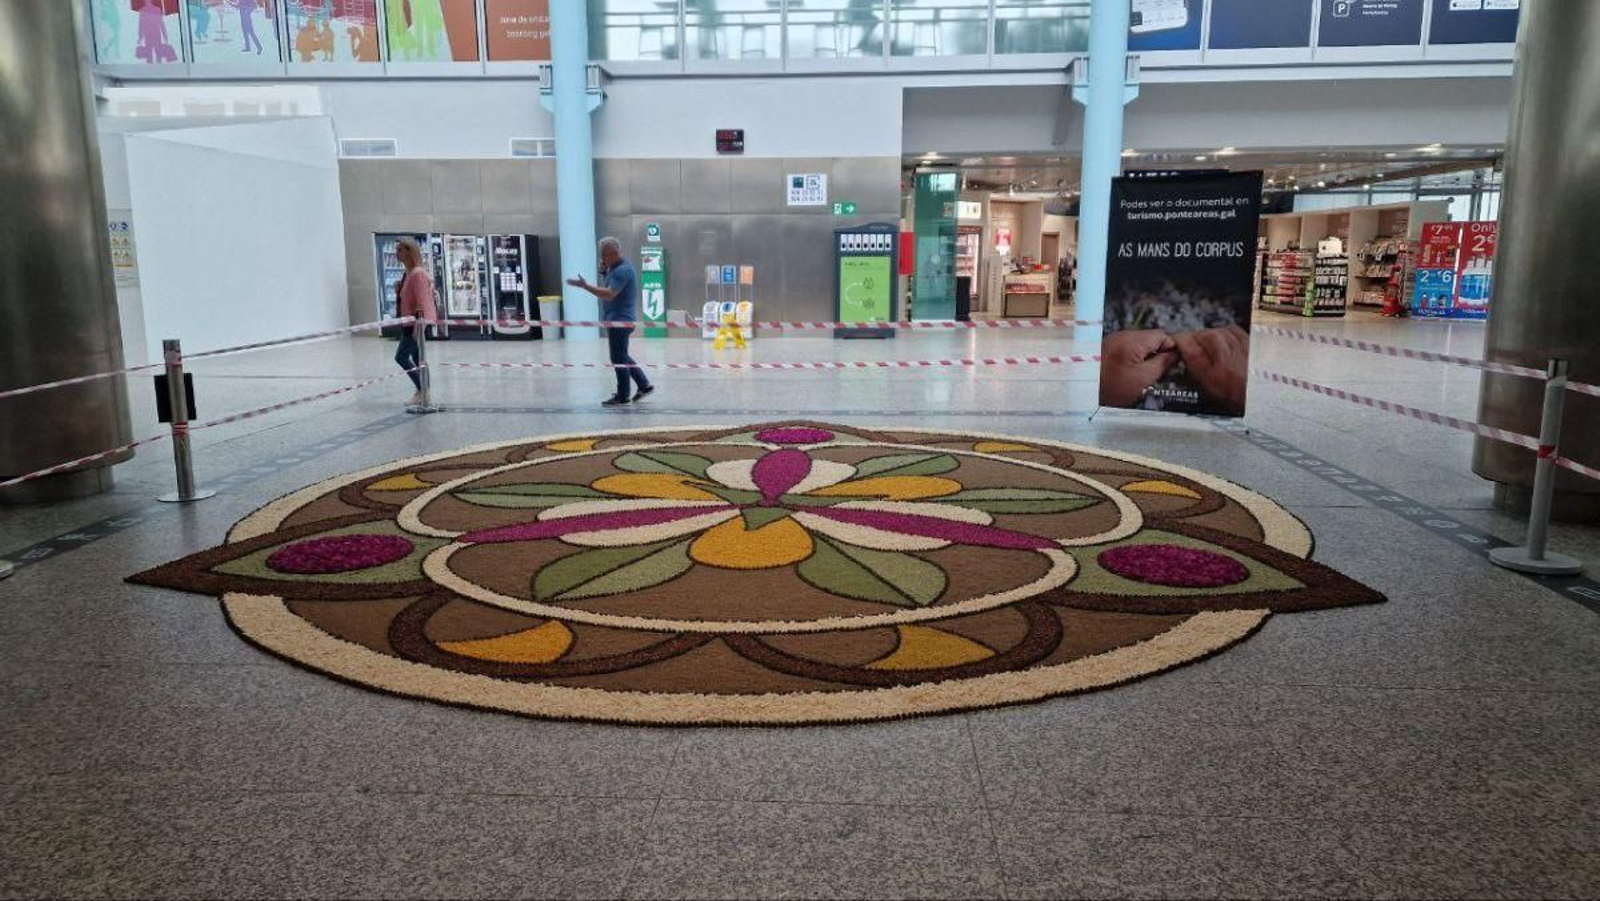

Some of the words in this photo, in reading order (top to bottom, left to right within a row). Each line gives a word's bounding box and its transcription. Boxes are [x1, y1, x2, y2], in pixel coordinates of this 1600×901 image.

[1120, 199, 1148, 209] Podes
[1149, 200, 1165, 208] ver
[1175, 196, 1234, 207] documental
[1235, 197, 1249, 206] en
[1127, 209, 1236, 220] turismo.ponteareas.gal
[1118, 243, 1133, 258] AS
[1137, 242, 1170, 258] MANS
[1174, 242, 1191, 257] DO
[1195, 241, 1244, 257] CORPUS
[1141, 386, 1199, 398] NTEAREAS
